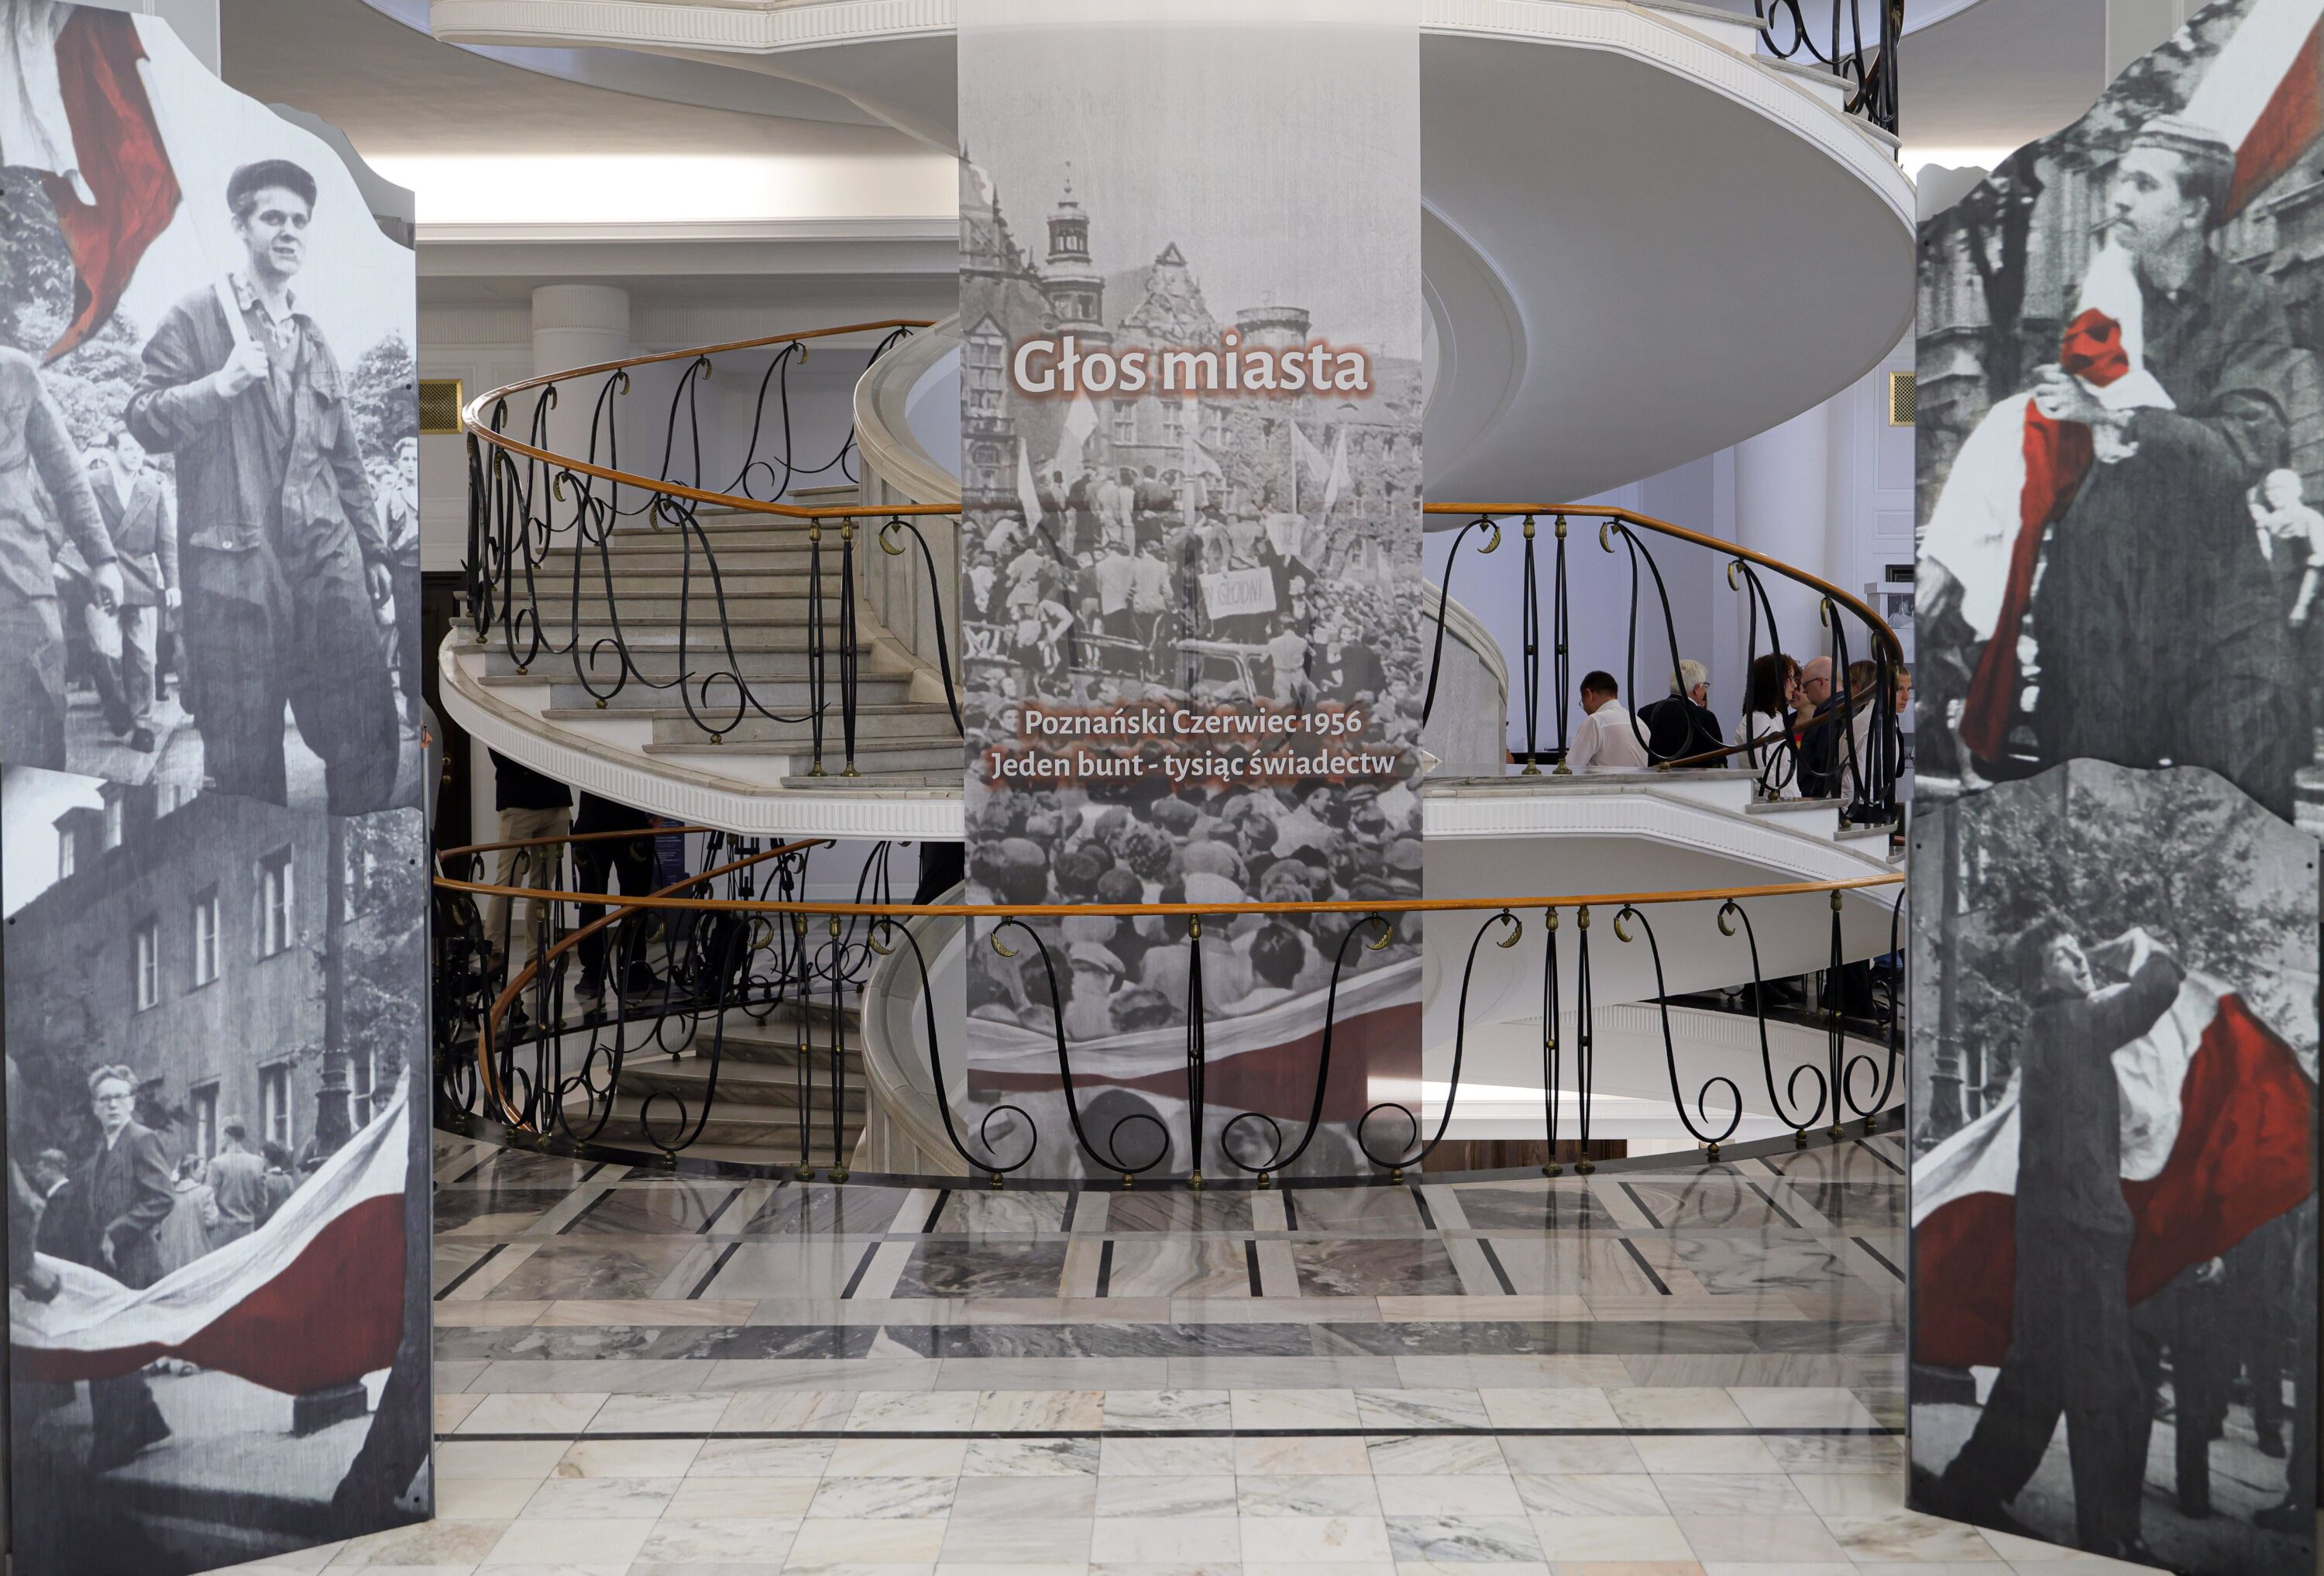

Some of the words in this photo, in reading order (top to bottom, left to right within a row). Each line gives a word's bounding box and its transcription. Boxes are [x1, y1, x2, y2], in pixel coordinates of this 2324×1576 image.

[1013, 336, 1146, 392] Głos
[1163, 334, 1368, 391] miasta
[1025, 707, 1166, 734] Poznański
[1172, 707, 1297, 734] Czerwiec
[1301, 711, 1362, 735] 1956
[992, 751, 1070, 779] Jeden
[1078, 751, 1143, 776] bunt
[1164, 750, 1244, 783] tysiąc
[1250, 748, 1395, 776] świadectw
